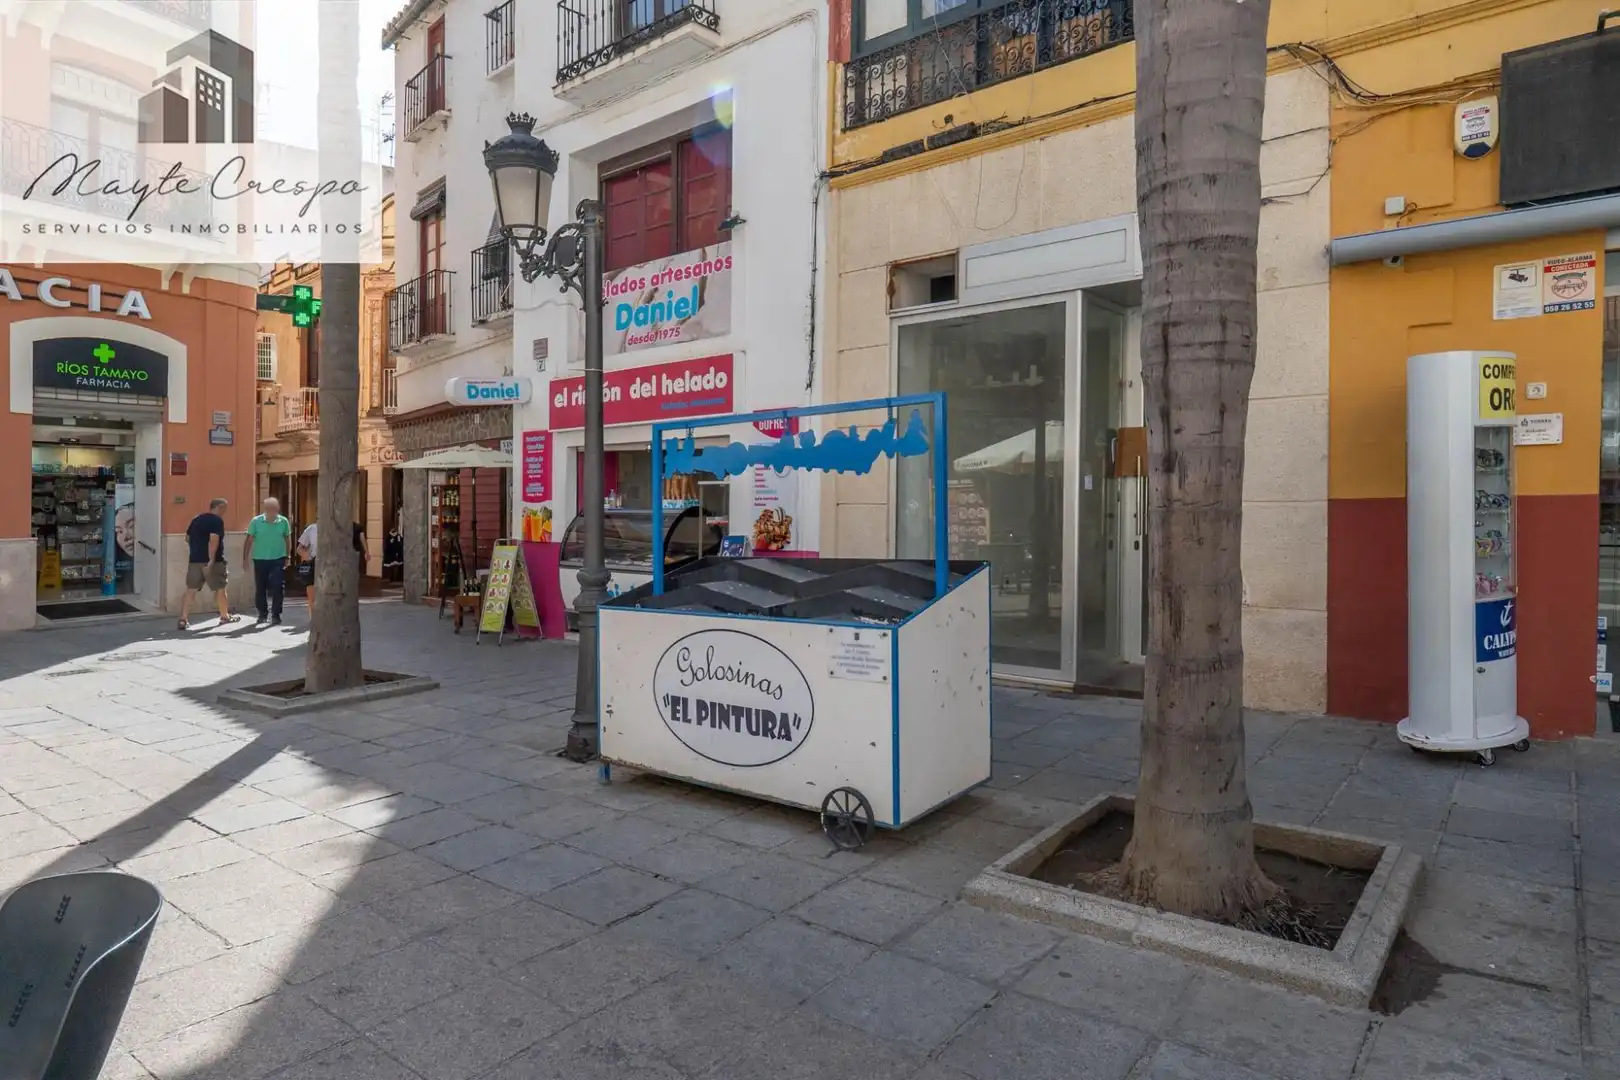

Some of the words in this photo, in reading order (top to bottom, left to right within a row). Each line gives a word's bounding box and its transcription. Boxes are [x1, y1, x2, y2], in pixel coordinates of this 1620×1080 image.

[602, 277, 646, 298] lados
[650, 255, 732, 287] artesanos
[1550, 262, 1589, 272] CONECTADA
[0, 268, 152, 319] ACIA
[615, 284, 699, 331] Daniel
[1545, 305, 1559, 313] 958
[1561, 303, 1570, 311] 26
[1572, 302, 1583, 310] 52
[627, 333, 656, 346] desde
[658, 326, 681, 340] 1975
[56, 360, 89, 376] RÍOS
[93, 366, 149, 381] TAMAYO
[76, 377, 131, 390] FARMACIA
[466, 382, 520, 400] Daniel
[554, 387, 568, 408] el
[571, 381, 621, 406] rión
[629, 375, 657, 399] del
[661, 366, 728, 396] helado
[677, 645, 783, 700] Golosinas
[695, 698, 802, 742] PINTURA"
